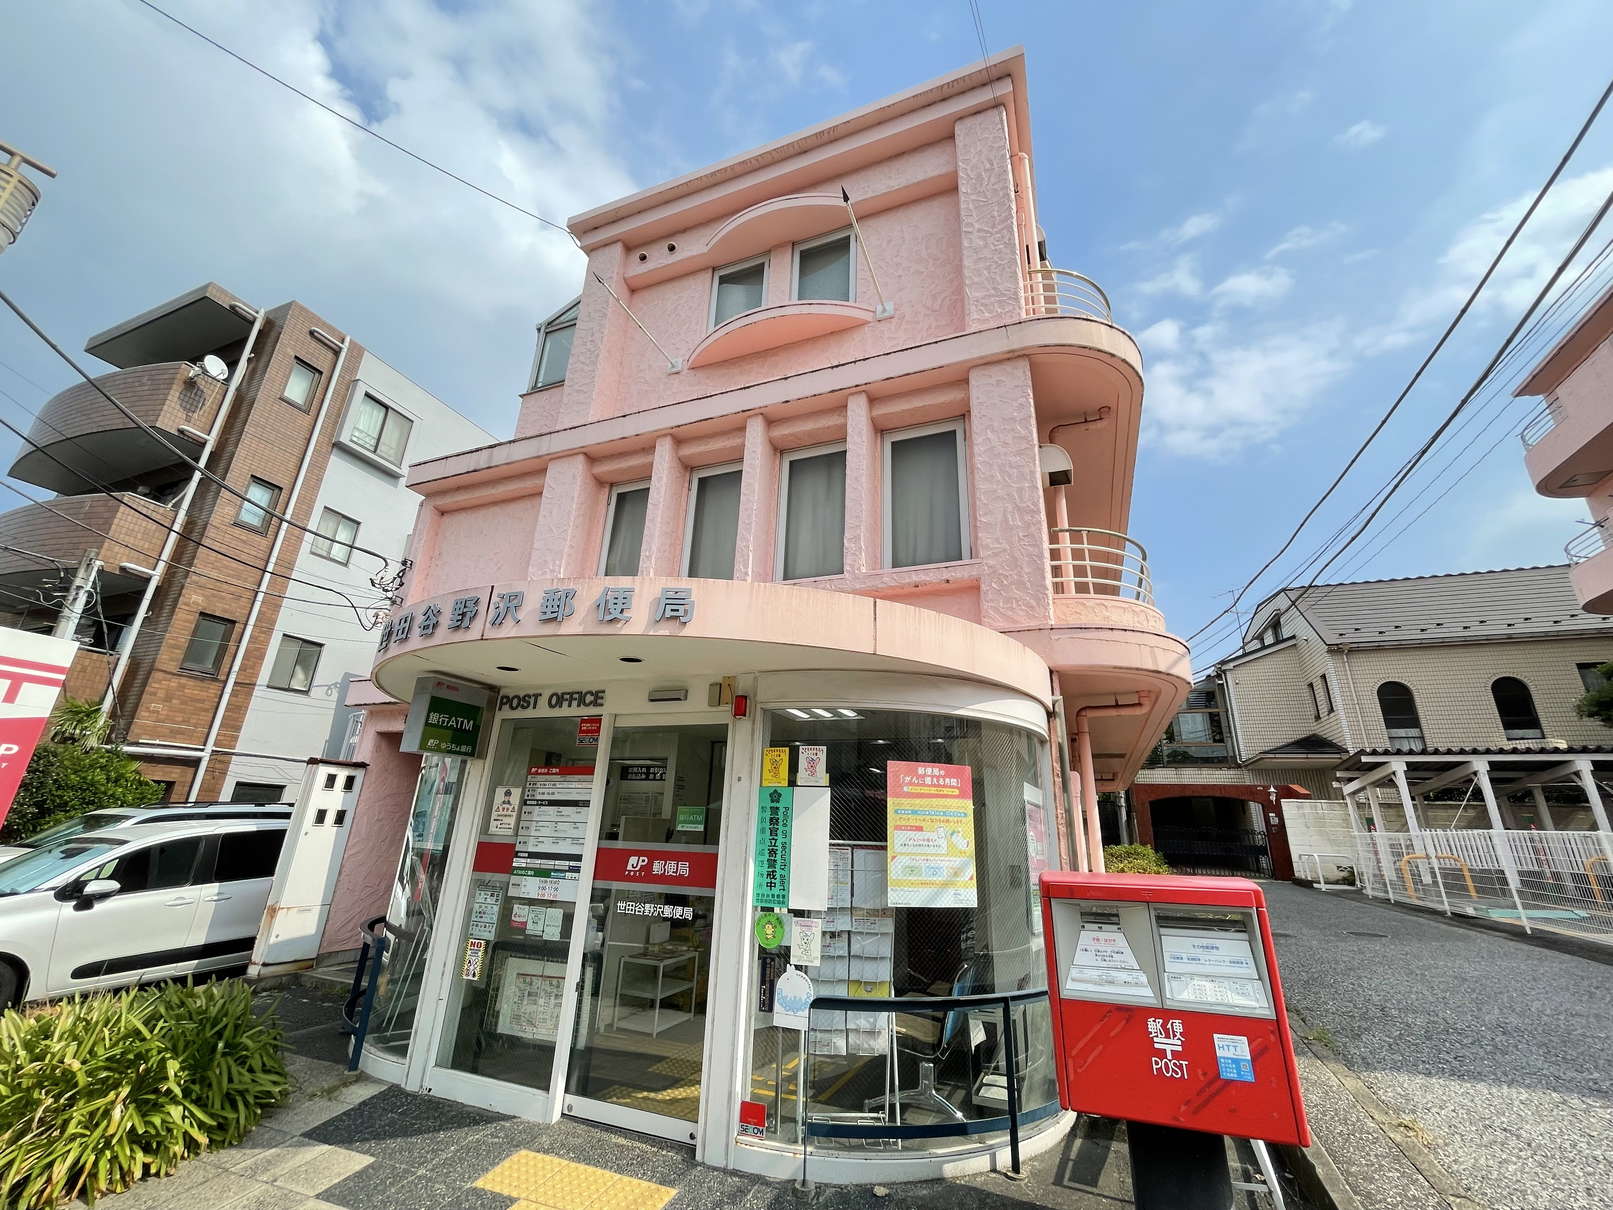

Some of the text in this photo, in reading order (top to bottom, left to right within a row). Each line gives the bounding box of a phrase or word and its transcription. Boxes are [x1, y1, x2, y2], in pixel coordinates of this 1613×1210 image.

[377, 586, 696, 653] 世田谷野沢郵便局
[498, 689, 606, 711] POST OFFICE
[427, 712, 474, 731] 銀行ATM
[781, 806, 790, 827] Police
[781, 829, 788, 839] on
[766, 806, 781, 891] 警察官立寄警戒中
[780, 841, 788, 872] security
[652, 860, 690, 877] 郵便局
[616, 900, 694, 921] 世田谷野沢郵便局
[469, 940, 483, 949] NO
[1147, 1018, 1185, 1041] 郵便
[1151, 1057, 1189, 1080] POST
